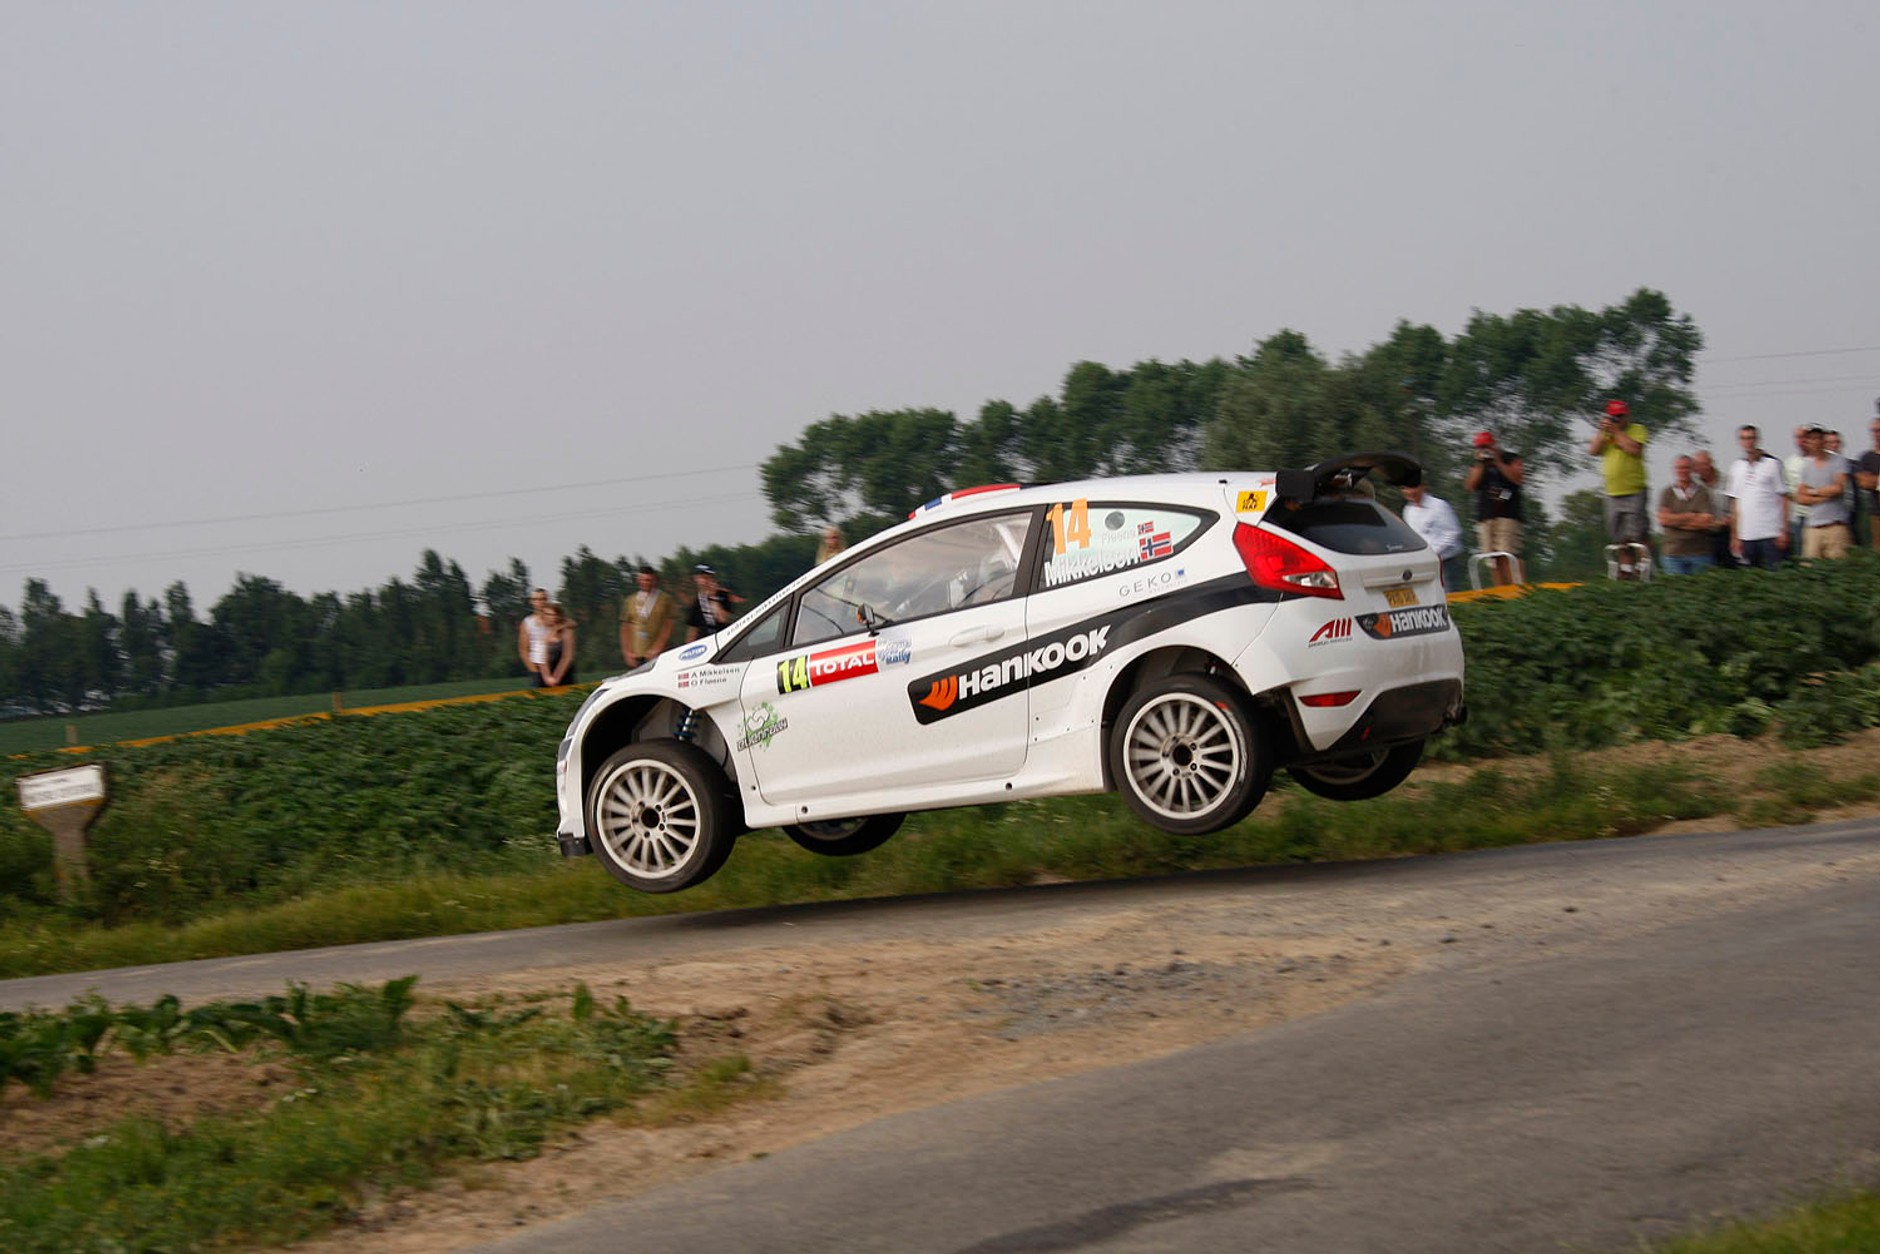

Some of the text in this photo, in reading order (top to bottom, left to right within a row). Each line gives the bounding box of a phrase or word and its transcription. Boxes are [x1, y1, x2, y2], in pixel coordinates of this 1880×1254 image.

[1046, 498, 1092, 555] 14
[1119, 572, 1172, 597] GEKO
[778, 653, 876, 693] 14 TOTAL
